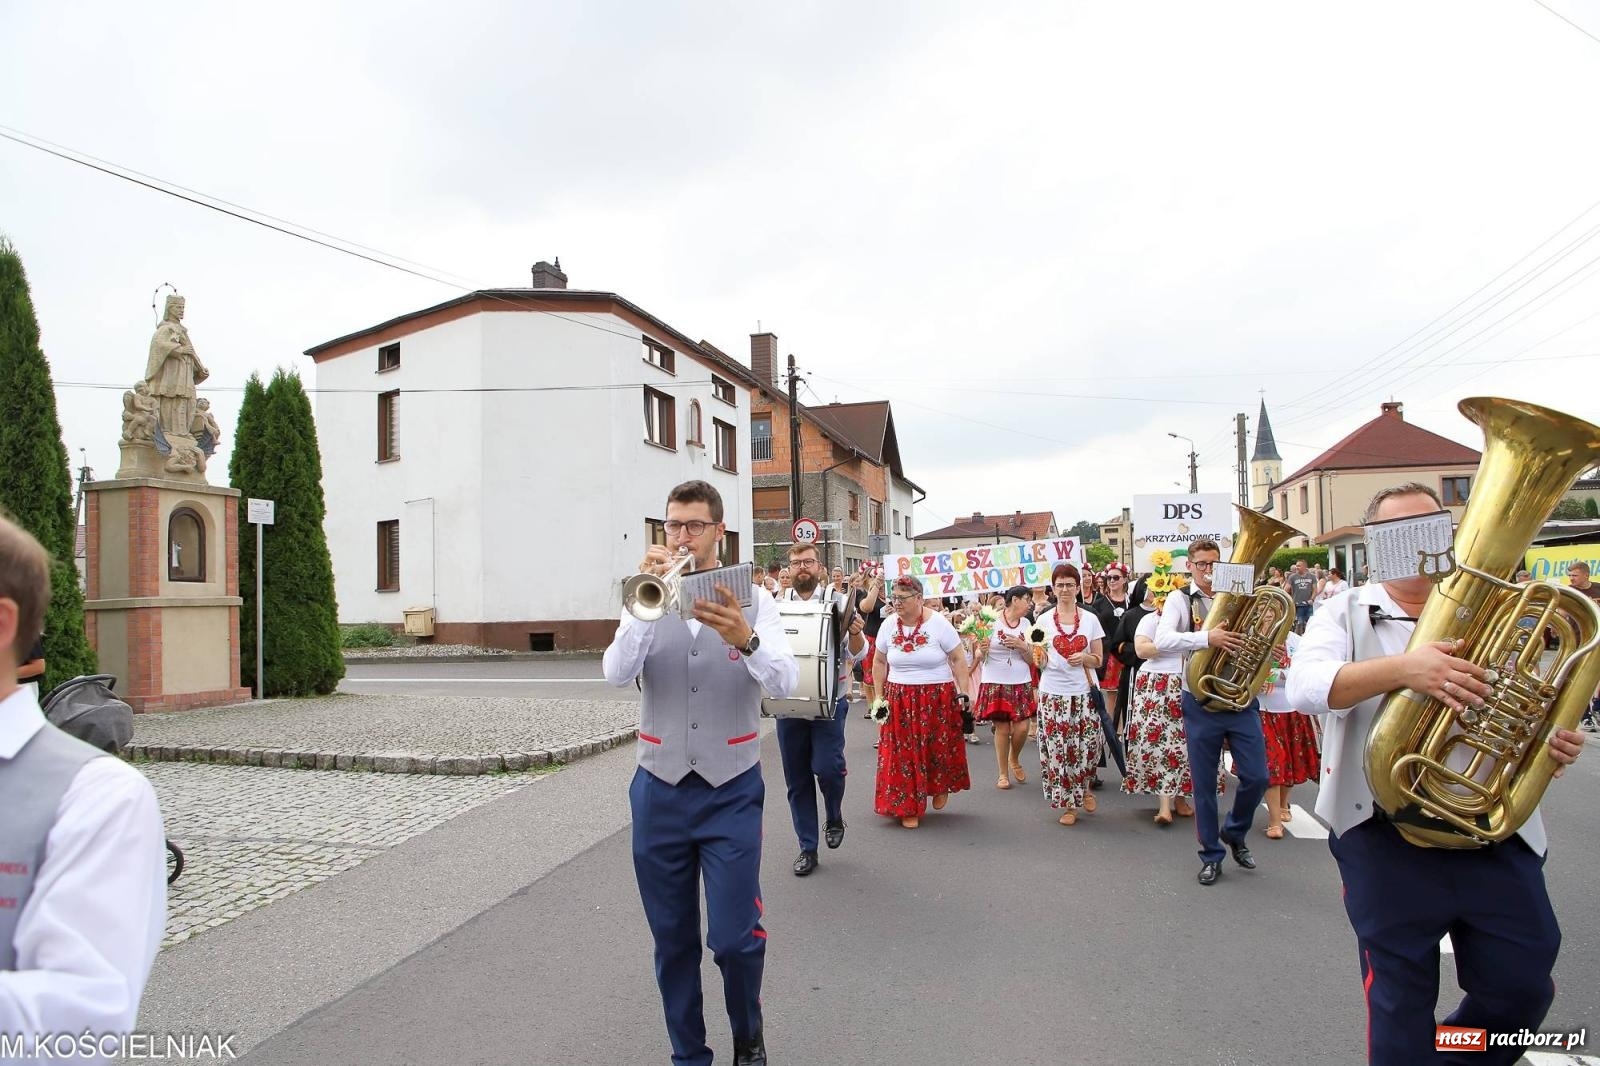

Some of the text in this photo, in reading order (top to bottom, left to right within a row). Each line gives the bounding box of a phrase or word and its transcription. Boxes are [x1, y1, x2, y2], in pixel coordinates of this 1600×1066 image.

[1162, 503, 1203, 520] DPS
[796, 527, 815, 539] 3,5t
[1145, 532, 1221, 543] KRZYŻANOWICE
[896, 540, 1075, 576] PRZEDSZKOLE W
